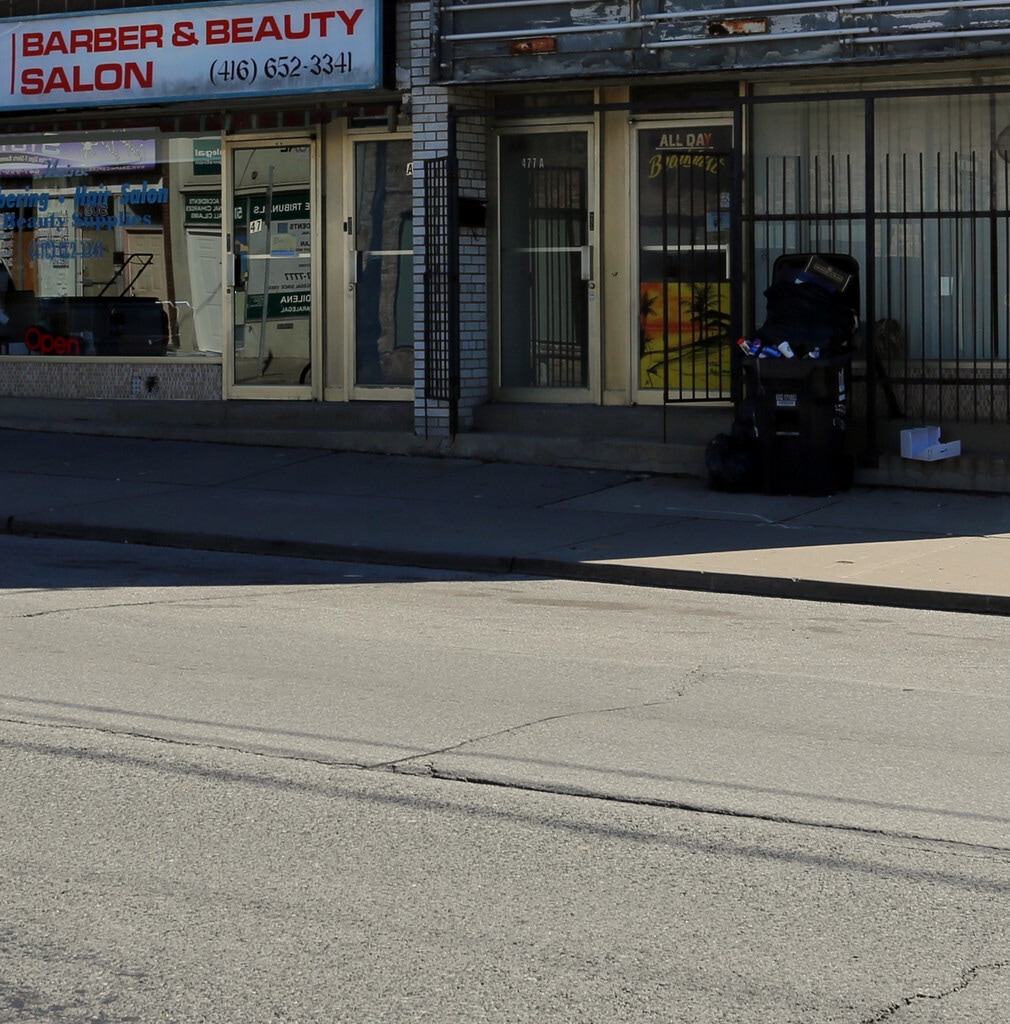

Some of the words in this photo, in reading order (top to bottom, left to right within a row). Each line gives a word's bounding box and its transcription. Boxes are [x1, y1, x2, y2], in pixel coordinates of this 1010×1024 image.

[22, 24, 163, 57] BARBER
[171, 21, 199, 46] &
[205, 9, 364, 45] BEAUTY
[21, 61, 154, 95] SALON
[209, 57, 258, 86] (416)
[263, 52, 353, 81] 652-3341
[659, 133, 683, 147] ALL
[686, 133, 713, 147] DAY
[74, 183, 112, 207] Hair
[120, 181, 169, 205] Salon
[3, 213, 66, 232] Beauty
[72, 211, 153, 232] Supplies
[23, 325, 81, 355] Open
